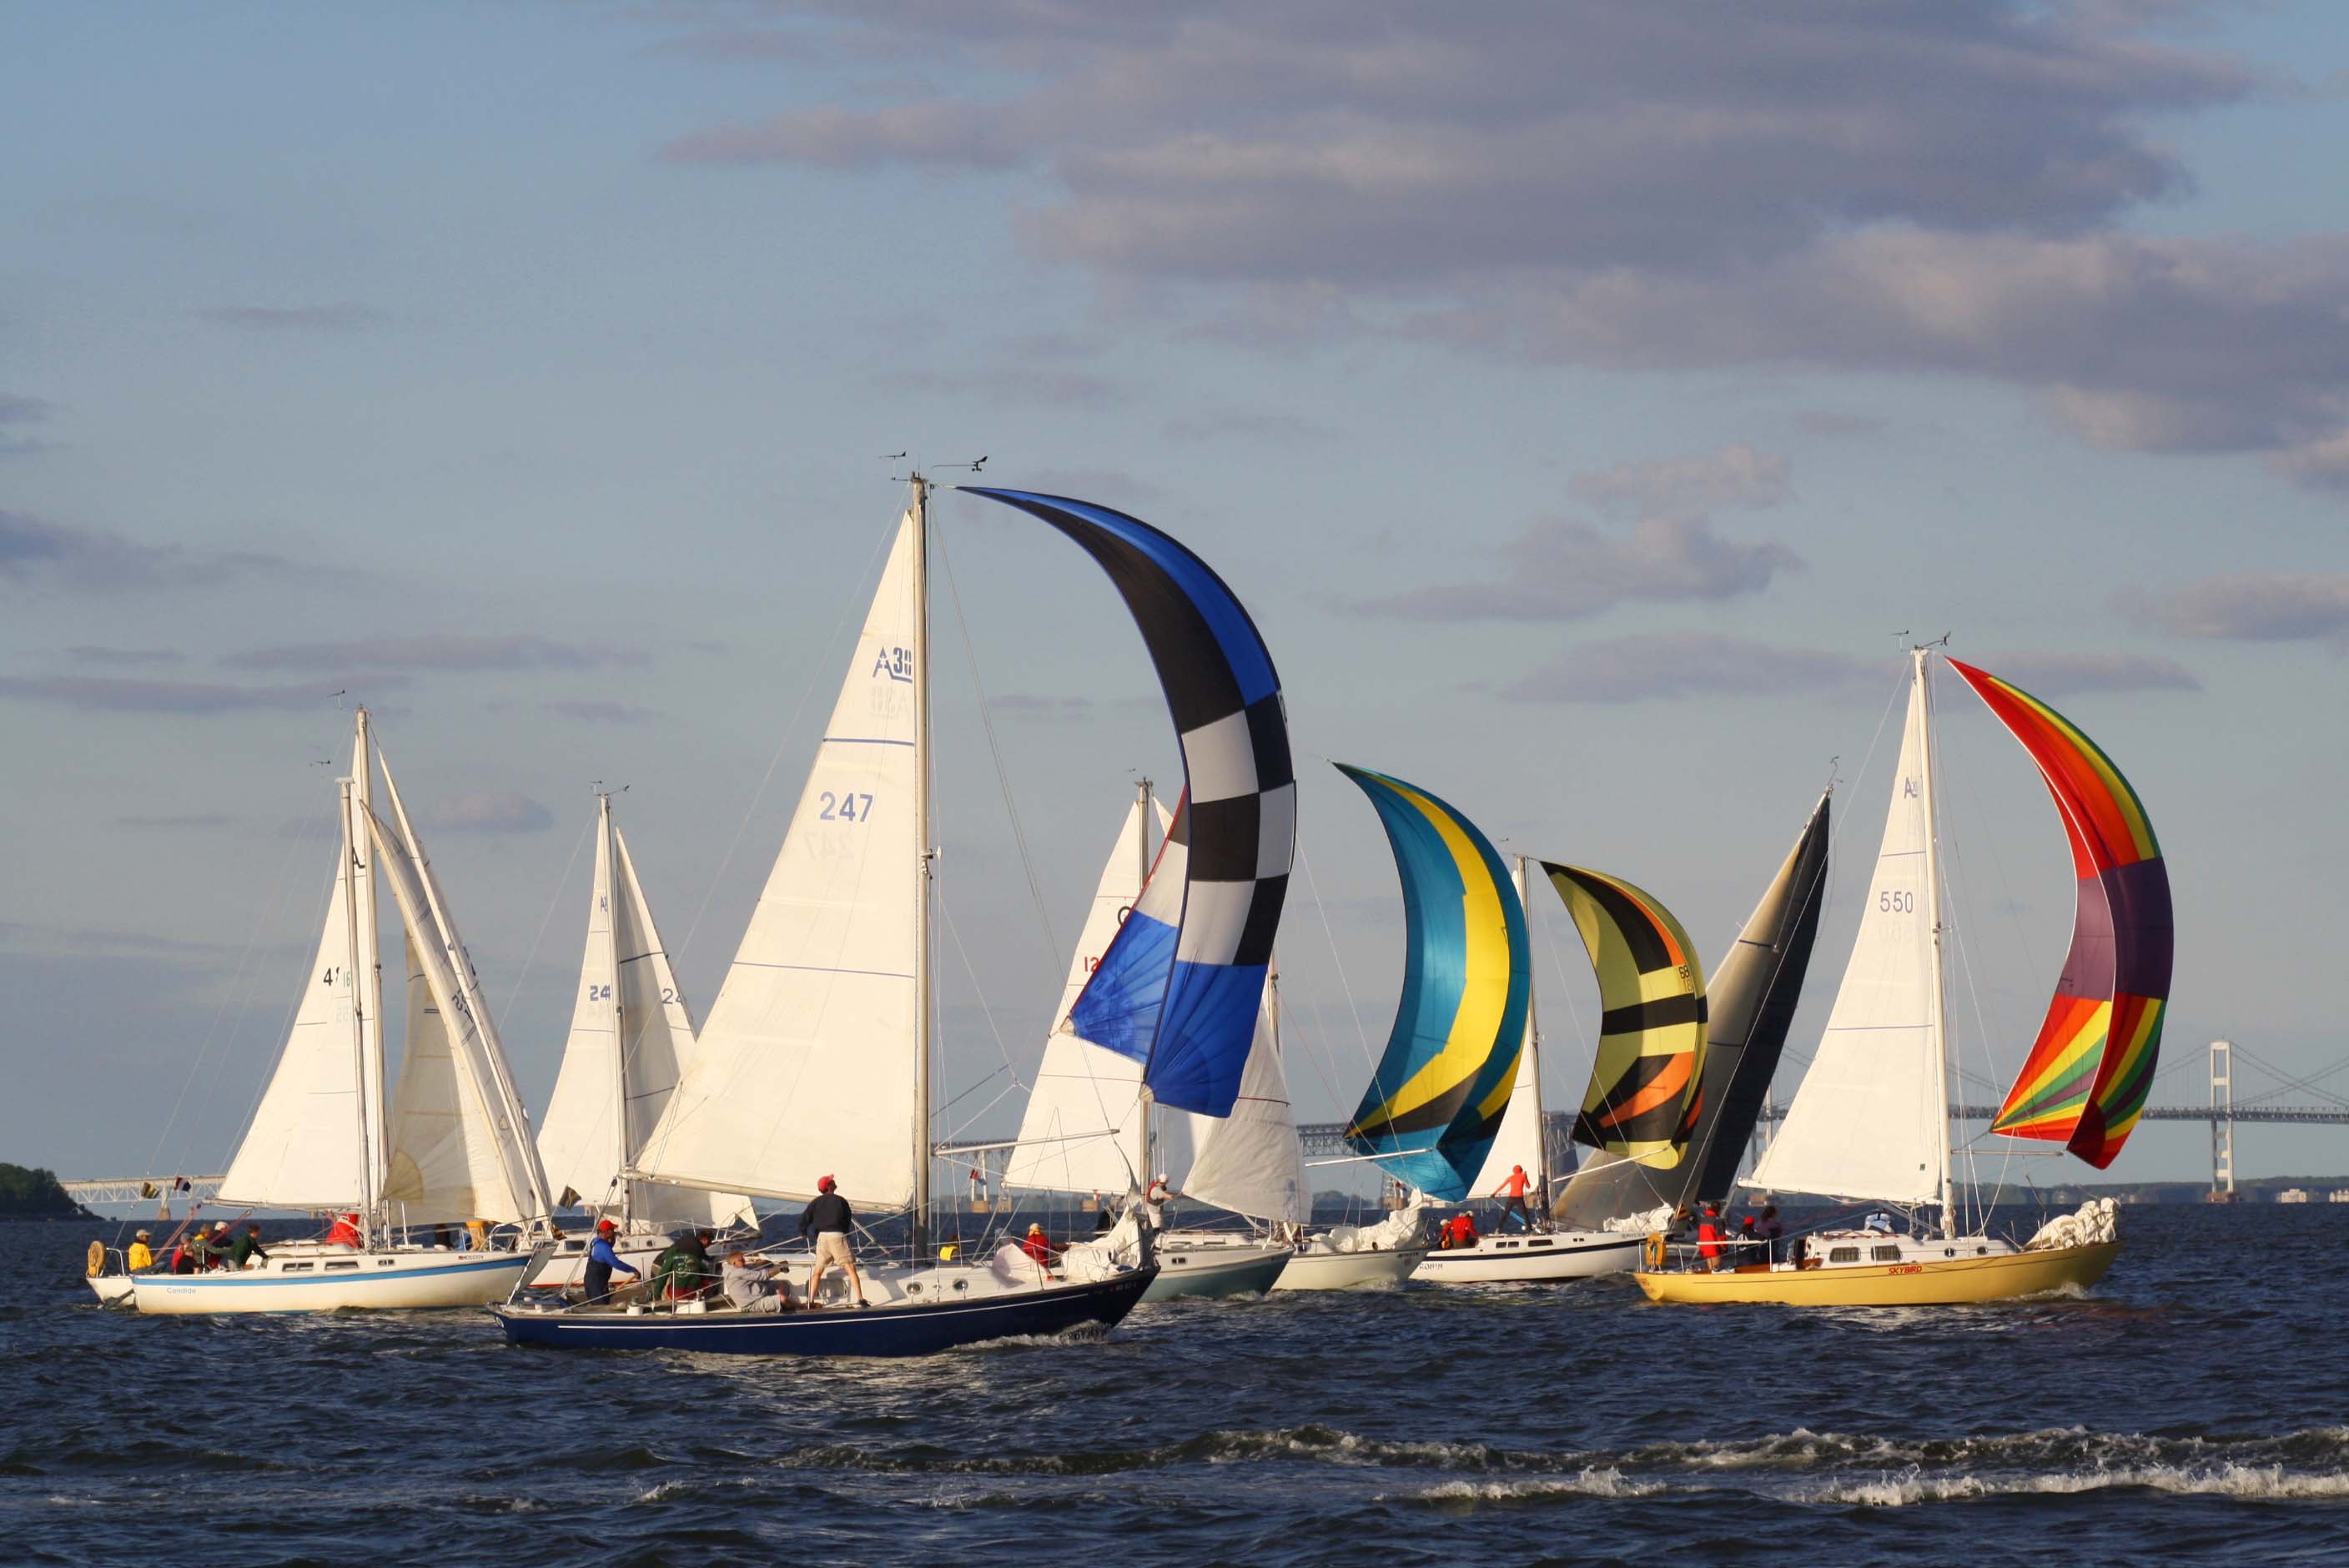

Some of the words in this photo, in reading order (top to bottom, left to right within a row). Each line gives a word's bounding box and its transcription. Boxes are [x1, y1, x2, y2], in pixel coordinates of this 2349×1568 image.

[820, 791, 873, 822] 247
[1879, 891, 1914, 913] 550
[1889, 1265, 1922, 1275] SKYBIRD
